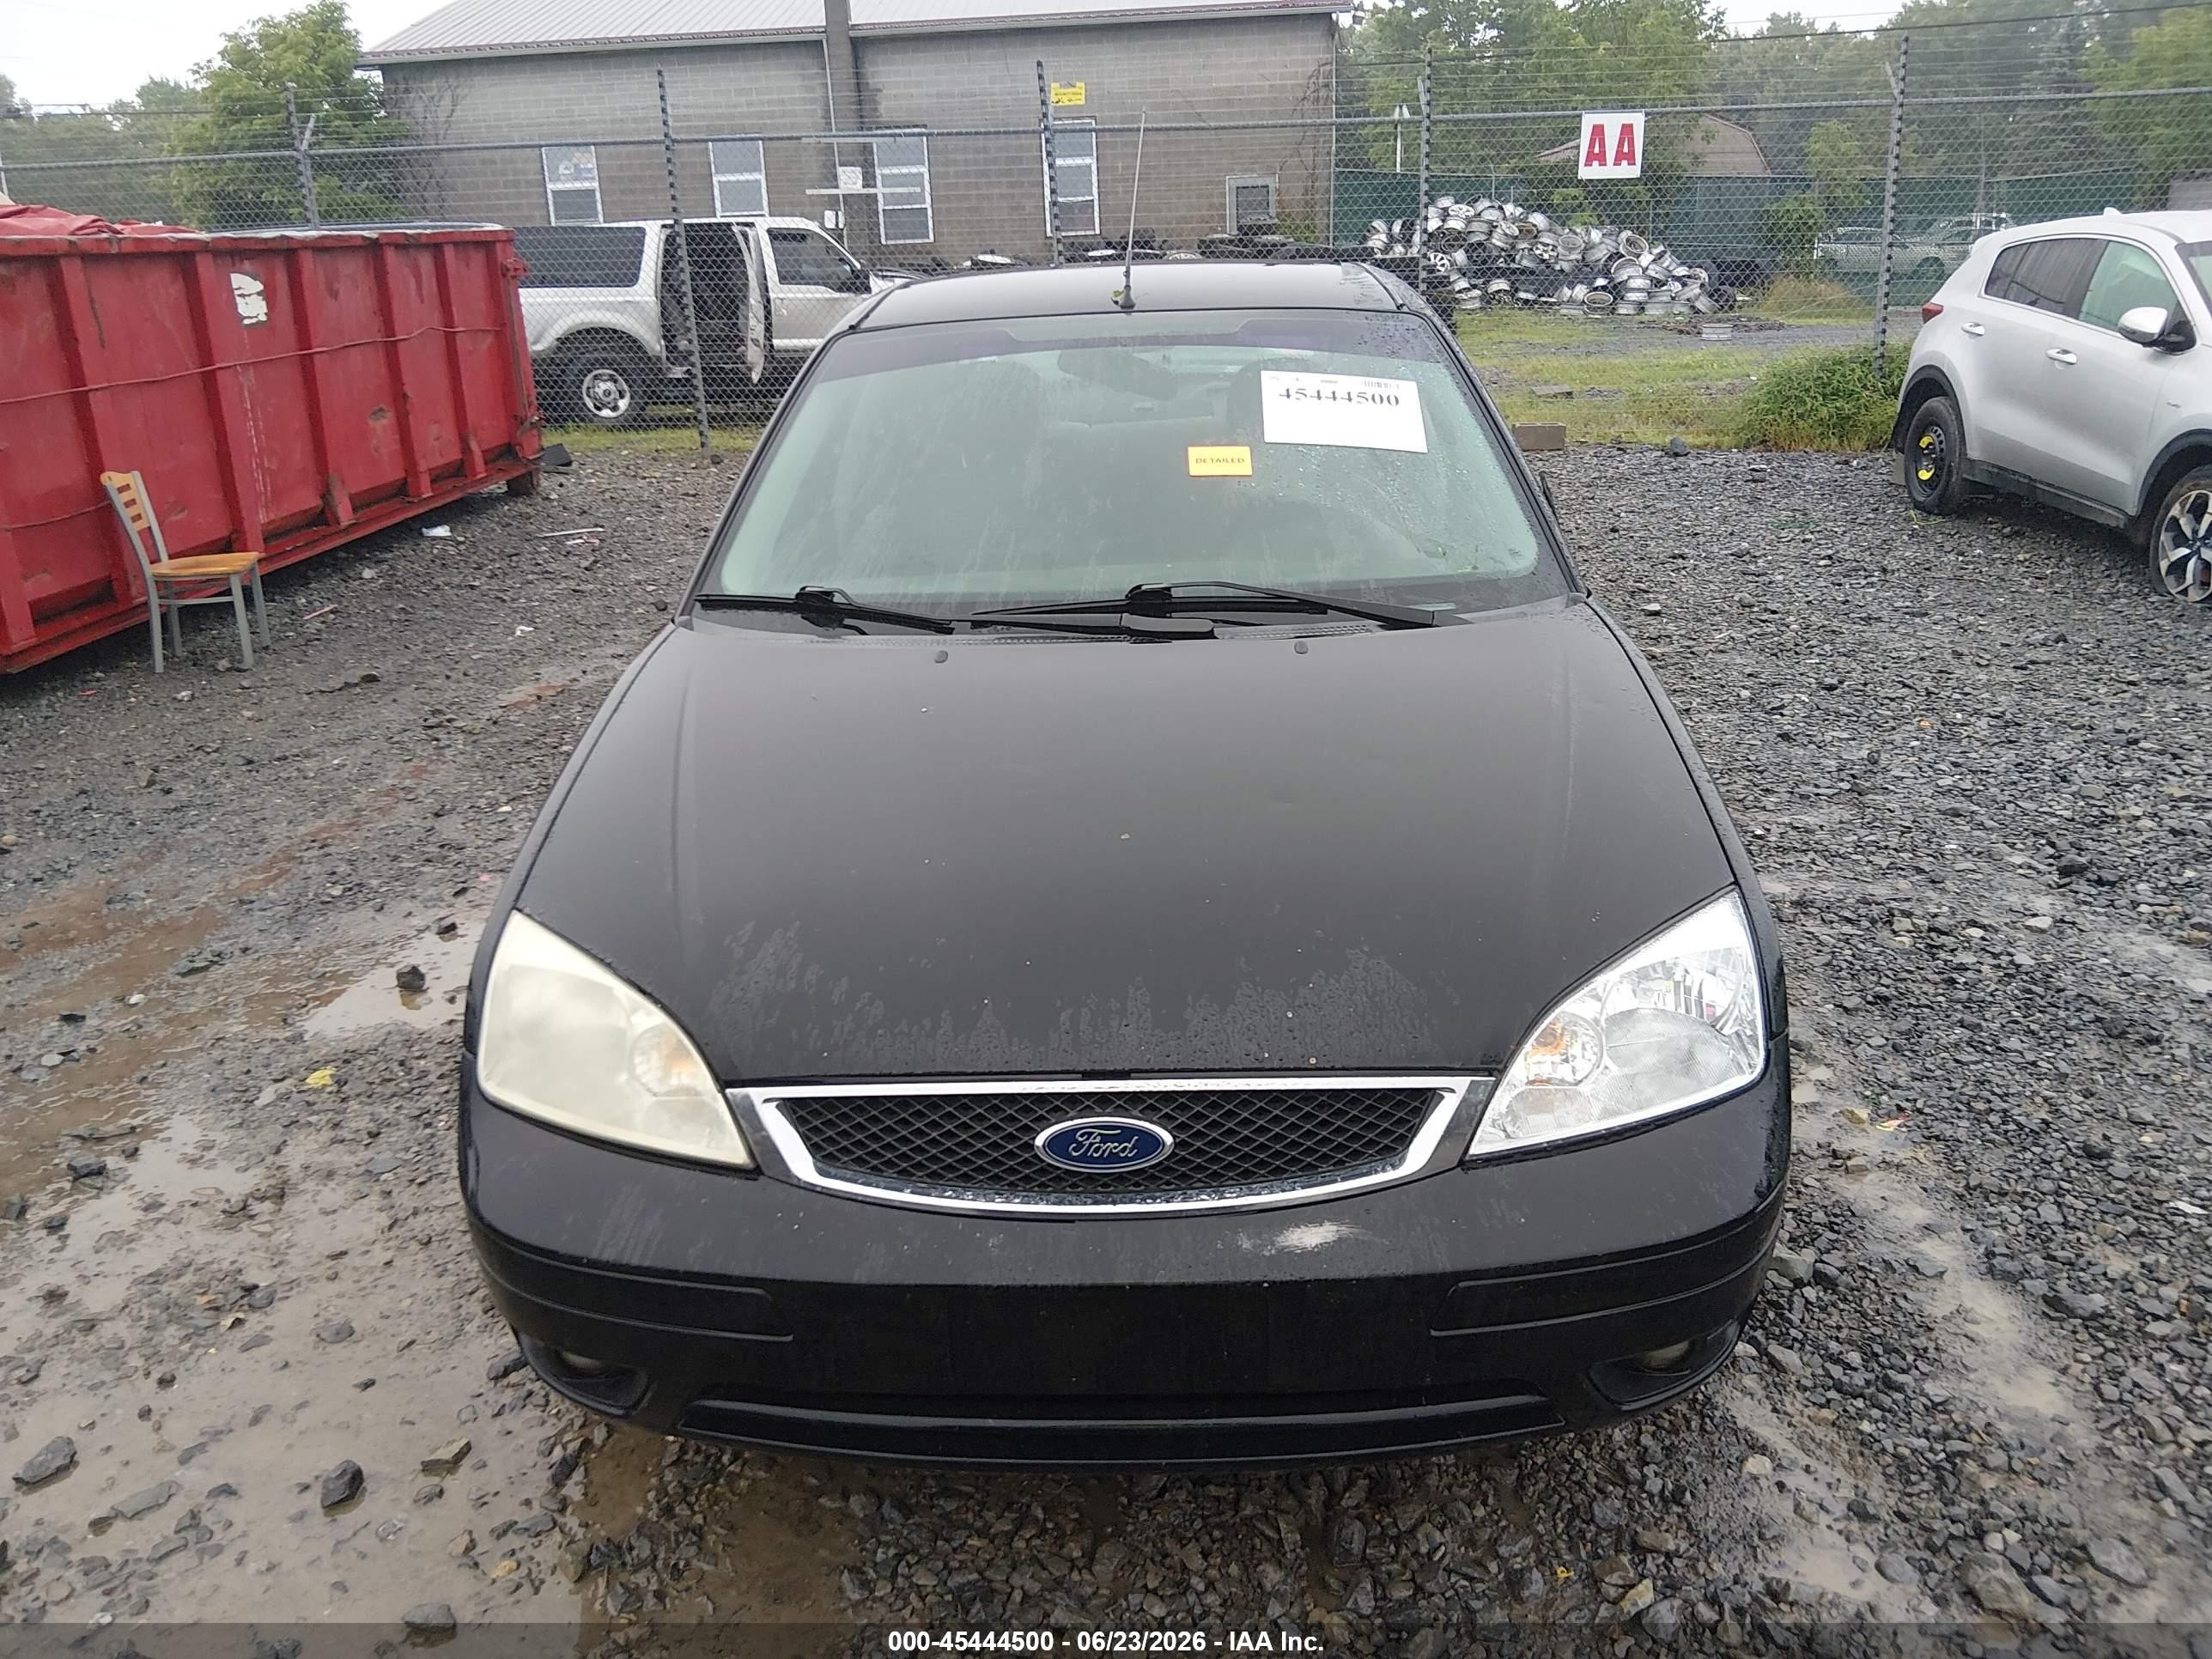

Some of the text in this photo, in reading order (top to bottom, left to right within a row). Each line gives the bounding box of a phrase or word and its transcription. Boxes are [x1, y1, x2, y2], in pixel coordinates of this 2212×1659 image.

[1583, 123, 1637, 167] AA
[1279, 387, 1400, 406] 45444500
[1069, 1128, 1139, 1158] Ford
